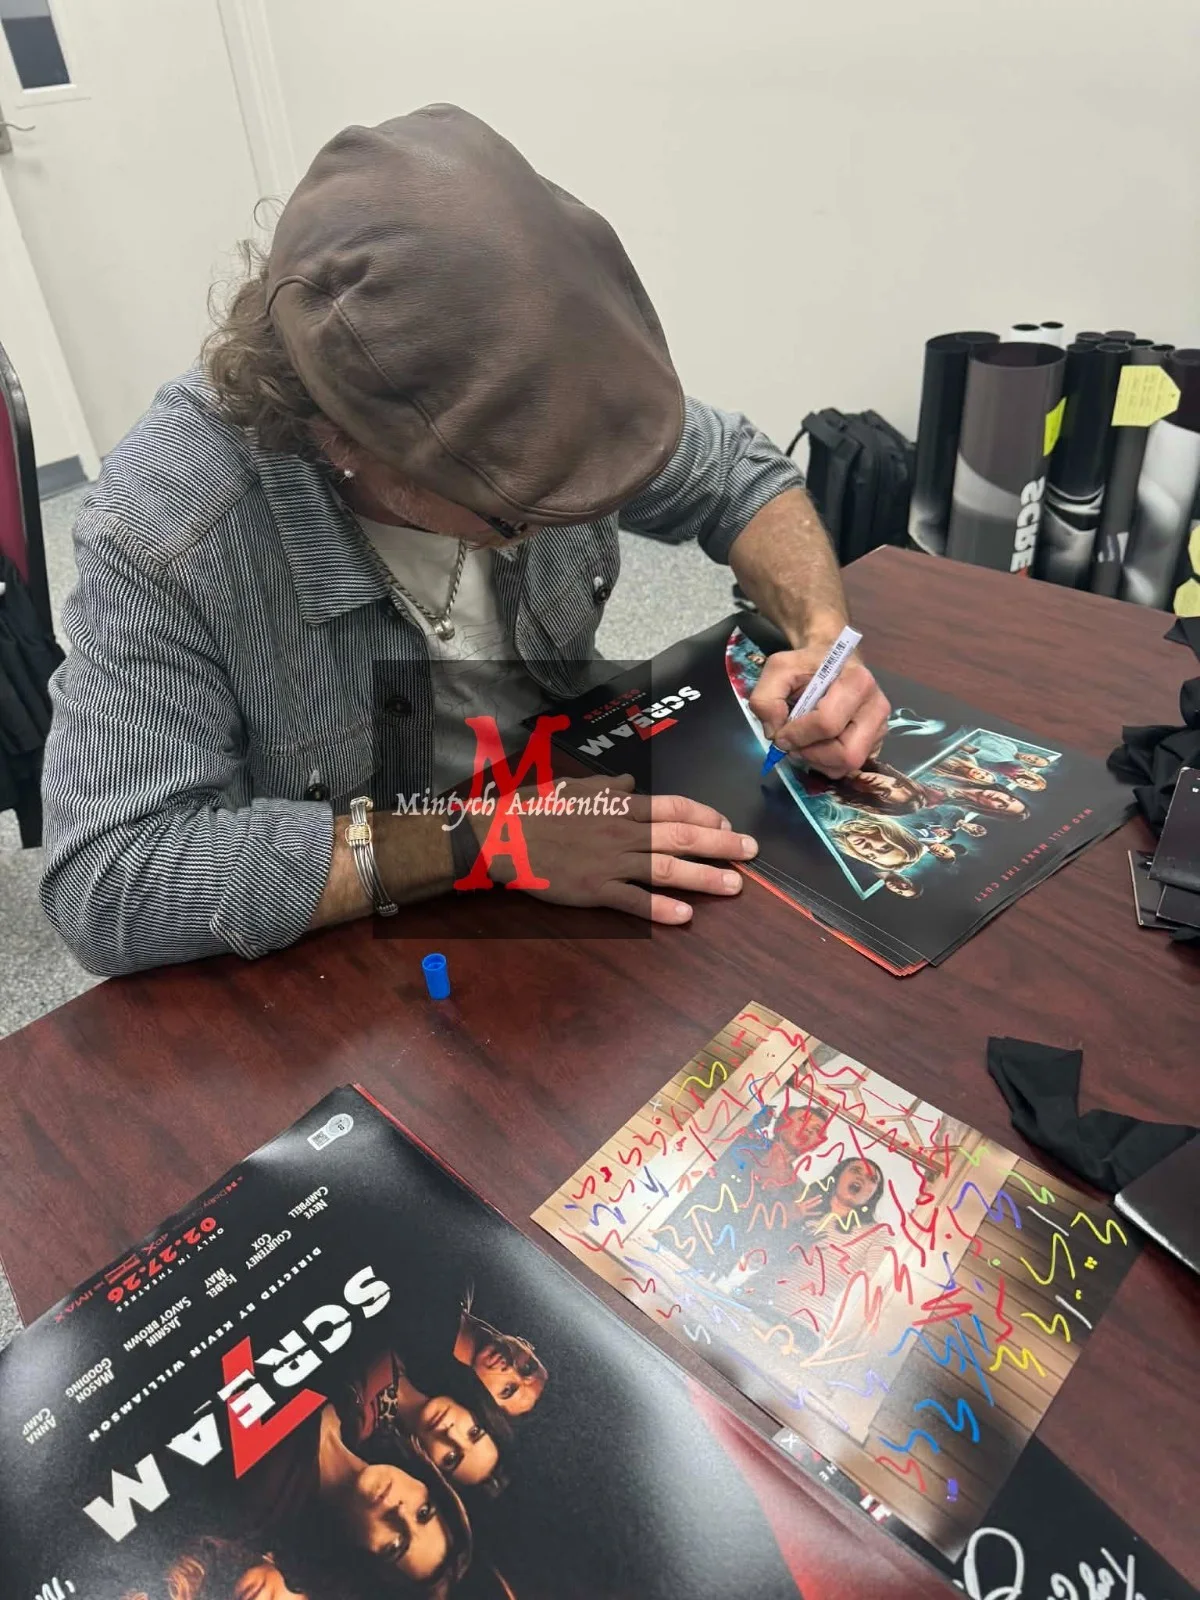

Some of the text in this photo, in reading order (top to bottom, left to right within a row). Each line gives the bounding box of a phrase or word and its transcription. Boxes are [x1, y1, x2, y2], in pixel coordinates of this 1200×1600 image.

[577, 686, 701, 757] SCREAM
[287, 1186, 329, 1218] CAMPBELL
[303, 1199, 328, 1220] NEVE
[245, 1230, 292, 1270] COURTENEY
[251, 1233, 272, 1251] COX
[107, 1217, 217, 1304] 02.27.26
[116, 1227, 224, 1313] ONLY IN THEATRES
[204, 1267, 227, 1288] MAY
[206, 1273, 238, 1298] ISABEL
[123, 1296, 192, 1352] SAVOY BROWN
[146, 1315, 182, 1348] JASMIN
[88, 1246, 322, 1443] DIRECTED BY KEVIN WILLIAMSON
[65, 1357, 113, 1398] GOODING
[75, 1369, 115, 1404] MASON
[21, 1407, 51, 1436] CAMP
[82, 1265, 392, 1543] SCREAM
[25, 1415, 58, 1445] ANNA
